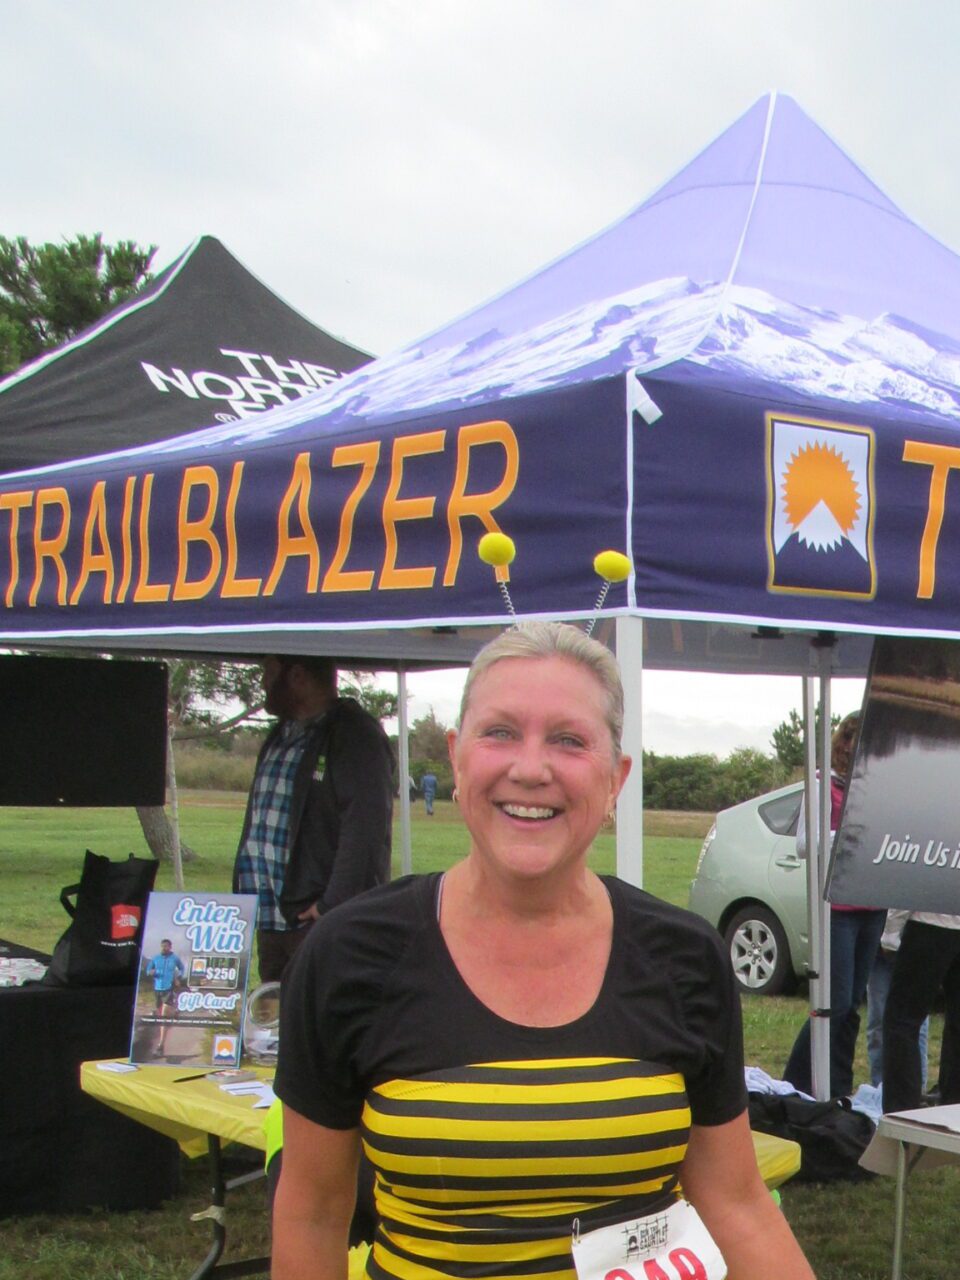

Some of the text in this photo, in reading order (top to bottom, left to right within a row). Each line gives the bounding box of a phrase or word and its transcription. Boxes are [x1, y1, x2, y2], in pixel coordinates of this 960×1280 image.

[0, 420, 519, 608] TRAILBLAZER
[873, 834, 918, 864] Join
[923, 840, 949, 867] Us
[173, 898, 240, 925] Enter
[186, 922, 243, 953] Win
[206, 967, 236, 980] $250
[178, 992, 203, 1012] Gift
